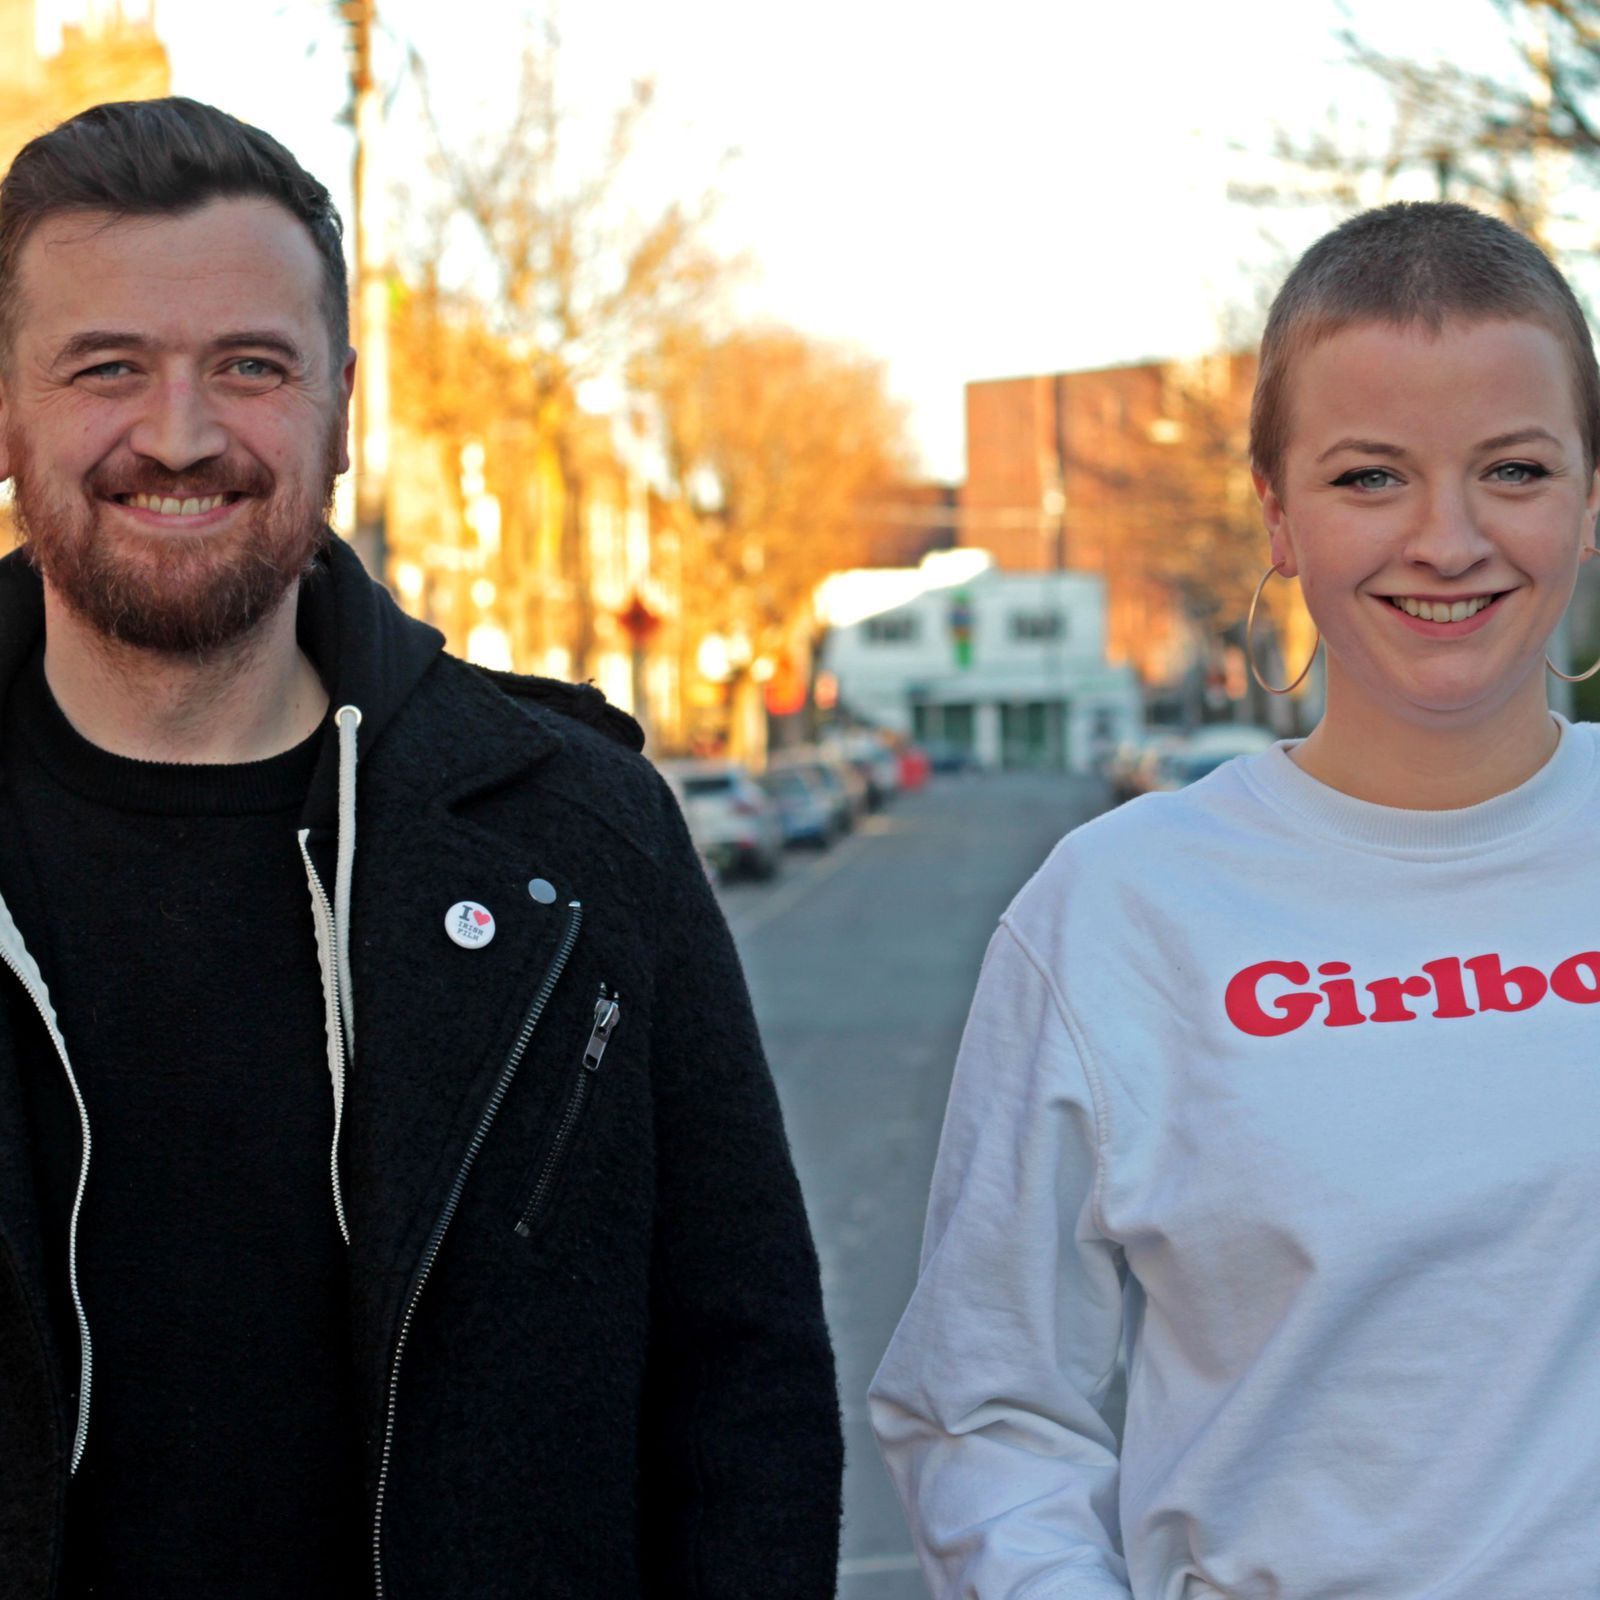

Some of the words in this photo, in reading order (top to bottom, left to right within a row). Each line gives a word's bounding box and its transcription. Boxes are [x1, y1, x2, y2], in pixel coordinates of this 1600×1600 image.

[459, 904, 473, 921] I
[457, 928, 479, 941] FILM
[458, 921, 484, 936] IRISH
[1225, 951, 1600, 1037] Girlbo
